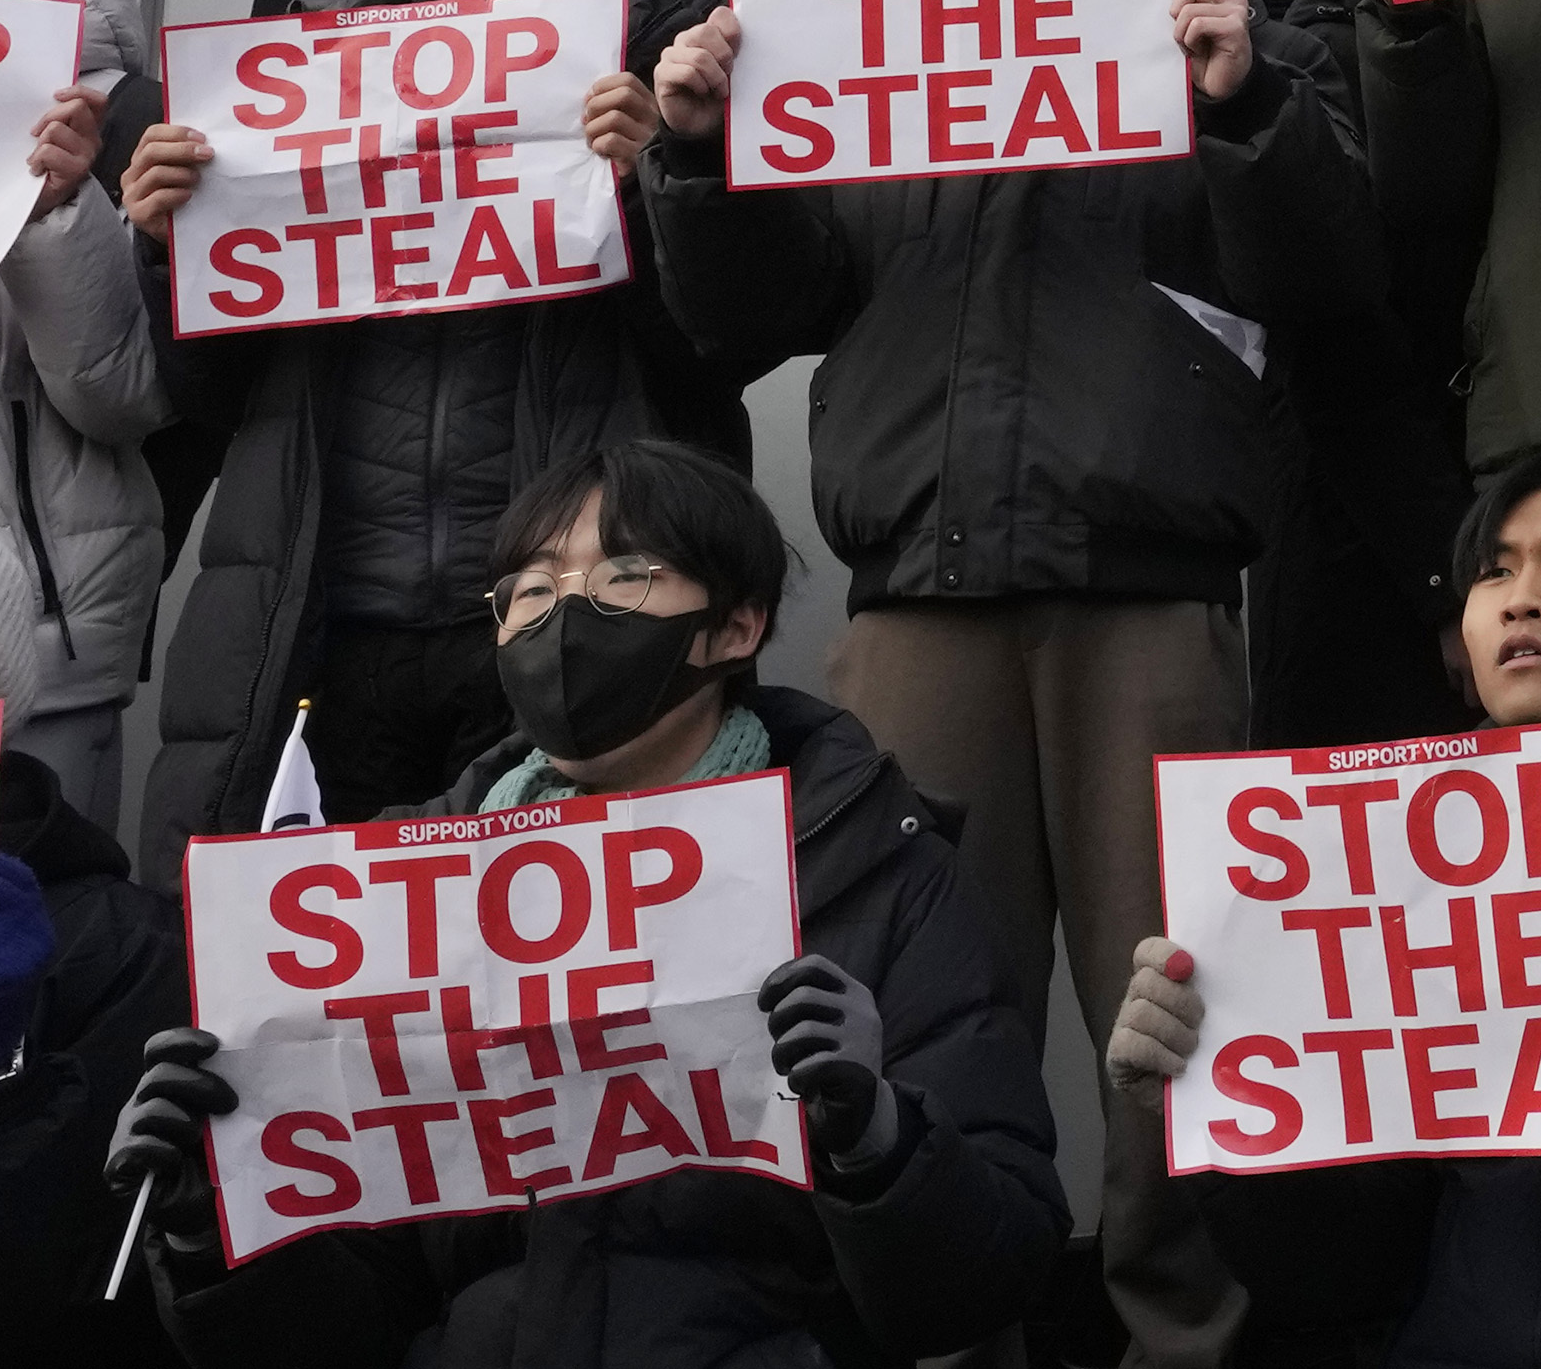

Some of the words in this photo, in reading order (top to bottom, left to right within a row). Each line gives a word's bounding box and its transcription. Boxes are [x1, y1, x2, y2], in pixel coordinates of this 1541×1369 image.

[335, 6, 412, 28] SUPPORT
[414, 1, 459, 18] YOON
[231, 16, 560, 130] STOP
[759, 60, 1162, 174] STEAL
[272, 109, 519, 216] THE
[207, 197, 602, 319] STEAL
[1327, 744, 1419, 772] SUPPORT
[1422, 737, 1479, 762] YOON
[397, 815, 495, 846] SUPPORT
[497, 804, 562, 833] YOON
[265, 825, 704, 991] STOP
[323, 959, 670, 1098] THE
[259, 1067, 780, 1219] STEAL
